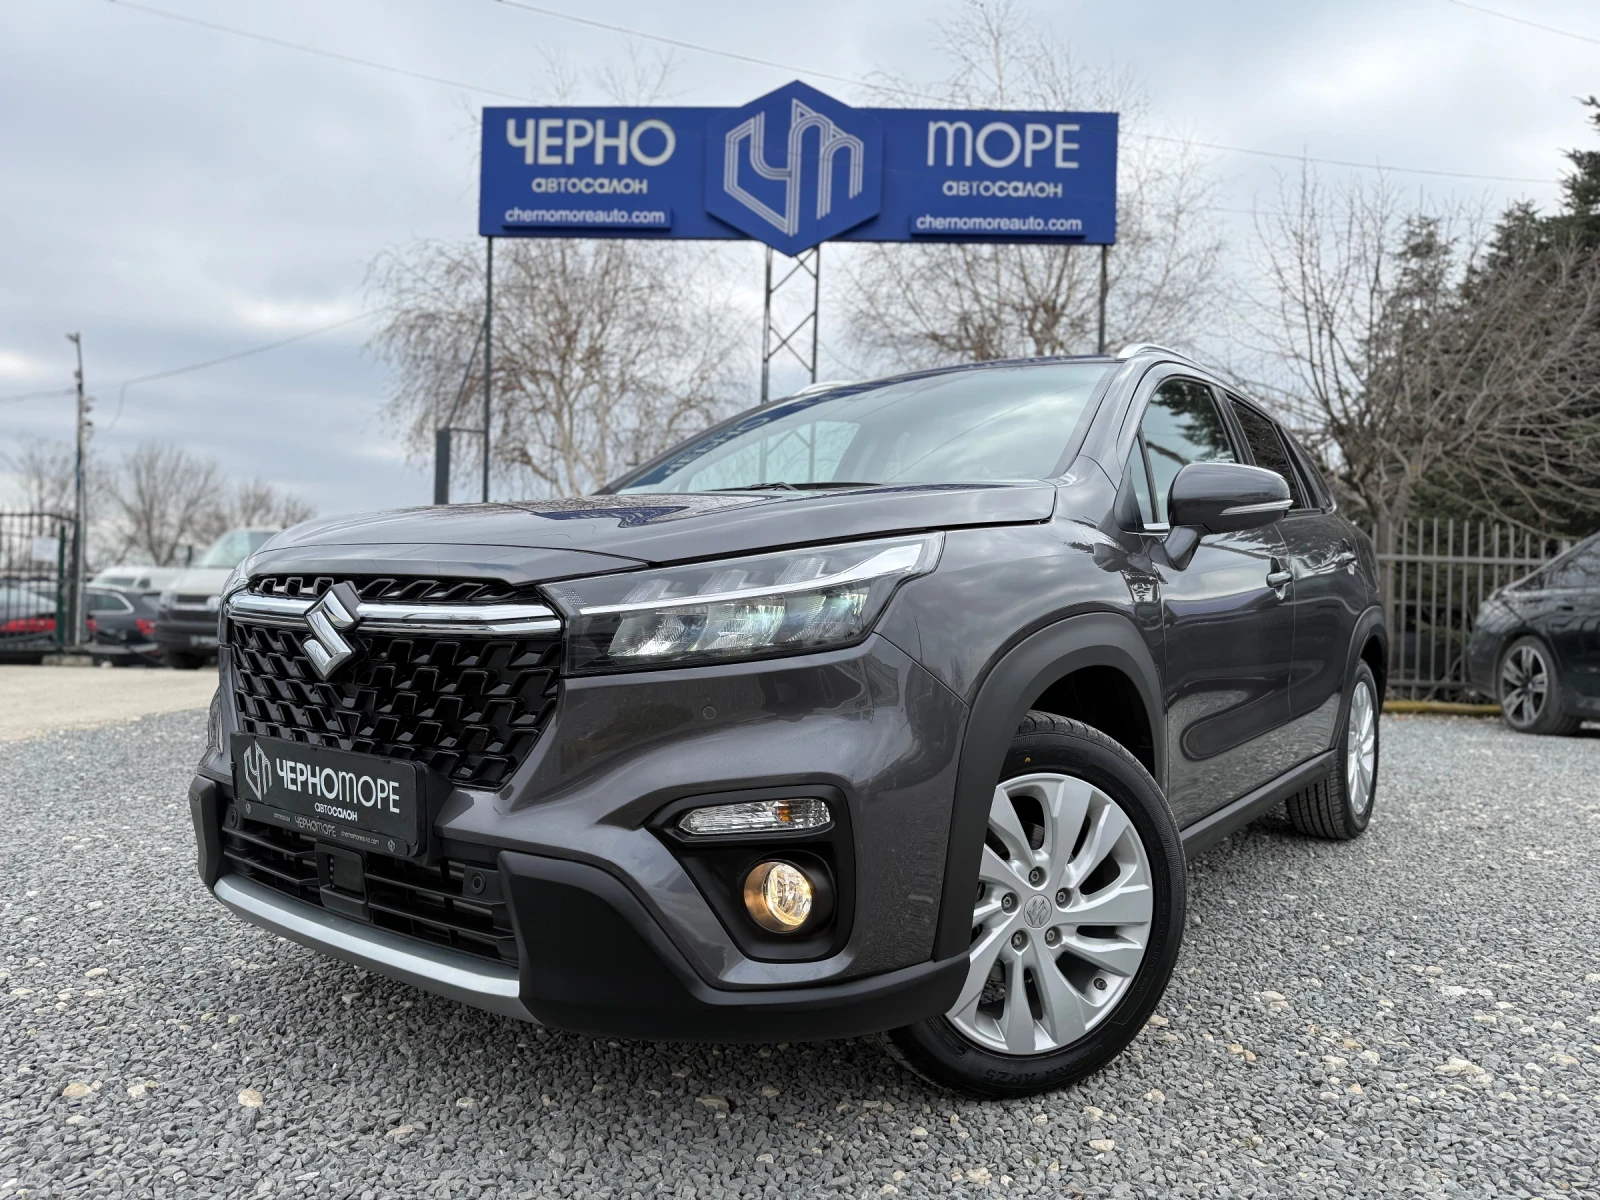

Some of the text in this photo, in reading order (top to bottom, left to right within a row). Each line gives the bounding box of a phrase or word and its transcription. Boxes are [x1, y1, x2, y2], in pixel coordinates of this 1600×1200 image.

[506, 118, 676, 166] ЧЕРНО
[531, 177, 648, 194] автосалон
[942, 180, 1062, 198] автосалон
[505, 207, 665, 224] chernomoreauto.com
[916, 214, 1082, 231] chernomoreauto.com
[314, 802, 358, 821] автосалон
